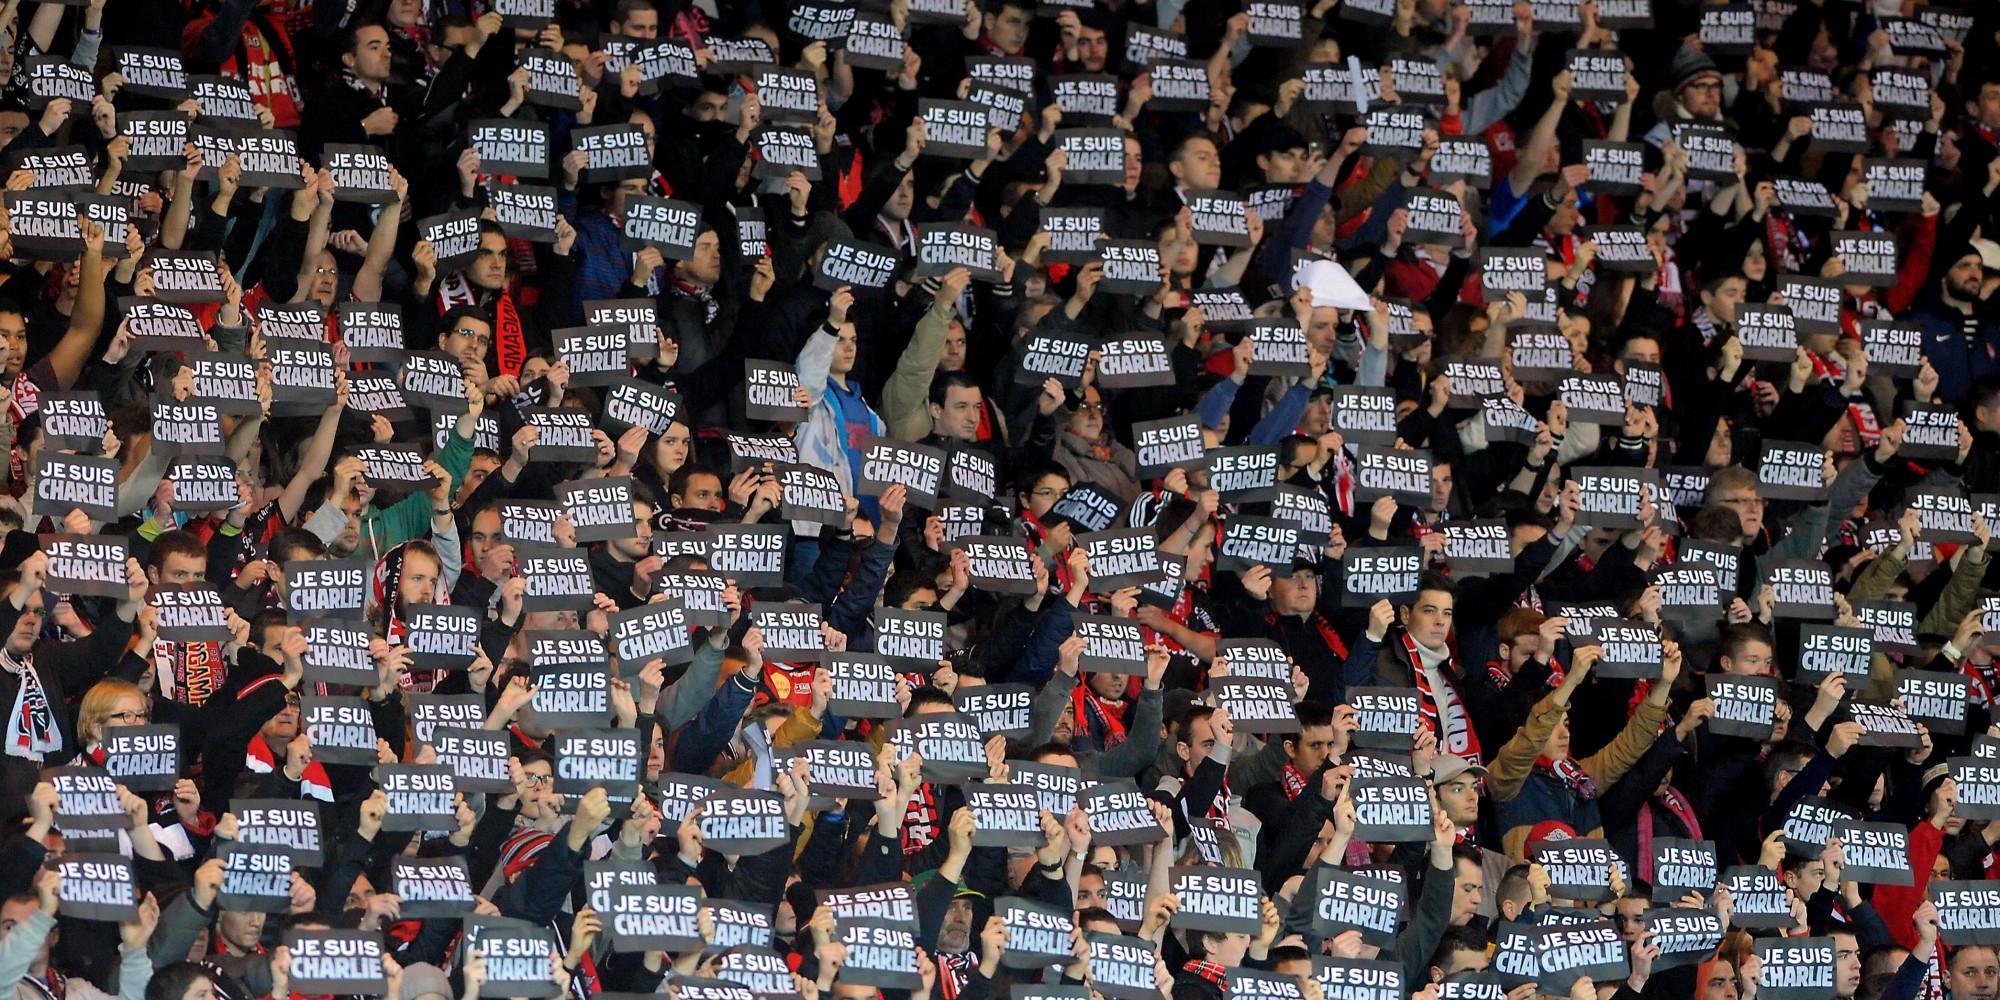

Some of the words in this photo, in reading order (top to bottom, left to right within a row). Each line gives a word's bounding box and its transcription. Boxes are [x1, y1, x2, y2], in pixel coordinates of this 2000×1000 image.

[1701, 12, 1719, 26] JE
[1720, 11, 1754, 25] SUIS
[1700, 26, 1753, 43] CHARLIE
[120, 53, 141, 66] JE
[143, 55, 182, 70] SUIS
[1569, 57, 1589, 71] JE
[1591, 58, 1624, 71] SUIS
[122, 66, 186, 89] CHARLIE
[757, 73, 779, 87] JE
[781, 75, 815, 91] SUIS
[1151, 65, 1172, 79] JE
[1173, 66, 1206, 81] SUIS
[1572, 71, 1624, 90] CHARLIE
[1872, 72, 1892, 85] JE
[1893, 73, 1927, 89] SUIS
[1152, 79, 1209, 99] CHARLIE
[1874, 84, 1929, 107] CHARLIE
[758, 88, 817, 111] CHARLIE
[923, 108, 945, 122] JE
[947, 110, 986, 126] SUIS
[925, 122, 985, 146] CHARLIE
[237, 138, 259, 151] JE
[262, 138, 295, 154] SUIS
[241, 152, 300, 175] CHARLIE
[330, 153, 351, 167] JE
[354, 154, 387, 170] SUIS
[332, 169, 391, 190] CHARLIE
[12, 201, 33, 215] JE
[37, 201, 76, 217] SUIS
[627, 204, 652, 219] JE
[655, 207, 696, 226] SUIS
[1408, 196, 1428, 210] JE
[1430, 198, 1461, 214] SUIS
[12, 216, 80, 238] CHARLIE
[1408, 210, 1461, 234] CHARLIE
[626, 219, 695, 247] CHARLIE
[922, 232, 946, 244] JE
[950, 232, 992, 250] SUIS
[741, 241, 767, 256] SUIS
[828, 244, 854, 261] JE
[855, 251, 896, 270] SUIS
[921, 246, 992, 269] CHARLIE
[823, 257, 890, 287] CHARLIE
[1484, 257, 1504, 270] JE
[1506, 257, 1544, 271] SUIS
[1483, 272, 1544, 290] CHARLIE
[1864, 329, 1888, 343] JE
[1889, 330, 1921, 345] SUIS
[271, 350, 292, 364] JE
[295, 351, 332, 366] SUIS
[1864, 343, 1920, 365] CHARLIE
[273, 366, 334, 388] CHARLIE
[1138, 430, 1159, 446] JE
[1159, 424, 1199, 443] SUIS
[866, 446, 892, 461] JE
[896, 450, 940, 473] SUIS
[1139, 440, 1203, 466] CHARLIE
[1210, 457, 1234, 472] JE
[1237, 453, 1276, 470] SUIS
[40, 462, 66, 478] JE
[69, 465, 114, 484] SUIS
[170, 465, 193, 479] JE
[197, 465, 233, 479] SUIS
[1361, 454, 1384, 468] JE
[1387, 456, 1428, 473] SUIS
[864, 458, 937, 495] CHARLIE
[1211, 469, 1275, 492] CHARLIE
[1360, 469, 1430, 493] CHARLIE
[39, 479, 114, 507] CHARLIE
[174, 481, 238, 501] CHARLIE
[712, 534, 737, 549] JE
[741, 534, 782, 549] SUIS
[1227, 524, 1252, 538] JE
[1254, 526, 1301, 546] SUIS
[47, 543, 73, 557] JE
[77, 543, 124, 561] SUIS
[711, 551, 781, 571] CHARLIE
[1223, 539, 1301, 563] CHARLIE
[50, 557, 125, 584] CHARLIE
[523, 559, 546, 574] JE
[547, 559, 587, 573] SUIS
[1348, 558, 1373, 572] JE
[1377, 556, 1419, 572] SUIS
[290, 572, 317, 587] JE
[321, 570, 362, 586] SUIS
[526, 575, 592, 596] CHARLIE
[1347, 573, 1418, 593] CHARLIE
[1770, 569, 1792, 582] JE
[1795, 569, 1830, 584] SUIS
[291, 588, 362, 610] CHARLIE
[1773, 583, 1833, 604] CHARLIE
[410, 615, 433, 630] JE
[436, 616, 477, 633] SUIS
[615, 619, 641, 639] JE
[643, 605, 689, 631] SUIS
[878, 618, 901, 634] JE
[904, 621, 943, 638] SUIS
[408, 631, 476, 655] CHARLIE
[619, 625, 689, 660] CHARLIE
[878, 635, 943, 660] CHARLIE
[1219, 685, 1243, 699] JE
[1245, 685, 1287, 699] SUIS
[1711, 683, 1734, 698] JE
[1737, 685, 1774, 703] SUIS
[1222, 700, 1295, 720] CHARLIE
[1715, 698, 1774, 724] CHARLIE
[108, 737, 131, 753] JE
[134, 735, 176, 752] SUIS
[560, 739, 587, 755] JE
[591, 739, 636, 756] SUIS
[107, 753, 175, 776] CHARLIE
[559, 757, 637, 780] CHARLIE
[384, 775, 409, 790] JE
[411, 775, 453, 790] SUIS
[387, 792, 455, 814] CHARLIE
[1356, 788, 1380, 802] JE
[1382, 787, 1427, 802] SUIS
[701, 800, 728, 816] JE
[731, 799, 781, 815] SUIS
[1356, 804, 1430, 825] CHARLIE
[701, 816, 784, 839] CHARLIE
[1840, 829, 1862, 844] JE
[1865, 831, 1905, 848] SUIS
[1658, 848, 1680, 863] JE
[1682, 850, 1714, 866] SUIS
[1842, 845, 1909, 870] CHARLIE
[1174, 876, 1202, 890] JE
[1207, 877, 1257, 895] SUIS
[1658, 865, 1716, 888] CHARLIE
[1321, 881, 1349, 899] JE
[1352, 880, 1400, 909] SUIS
[614, 896, 642, 912] JE
[646, 896, 697, 914] SUIS
[1177, 891, 1258, 919] CHARLIE
[615, 914, 698, 937] CHARLIE
[1319, 898, 1396, 933] CHARLIE
[290, 939, 321, 956] JE
[324, 940, 380, 956] SUIS
[1761, 949, 1784, 964] JE
[1788, 948, 1832, 964] SUIS
[291, 957, 382, 979] CHARLIE
[1760, 966, 1833, 987] CHARLIE
